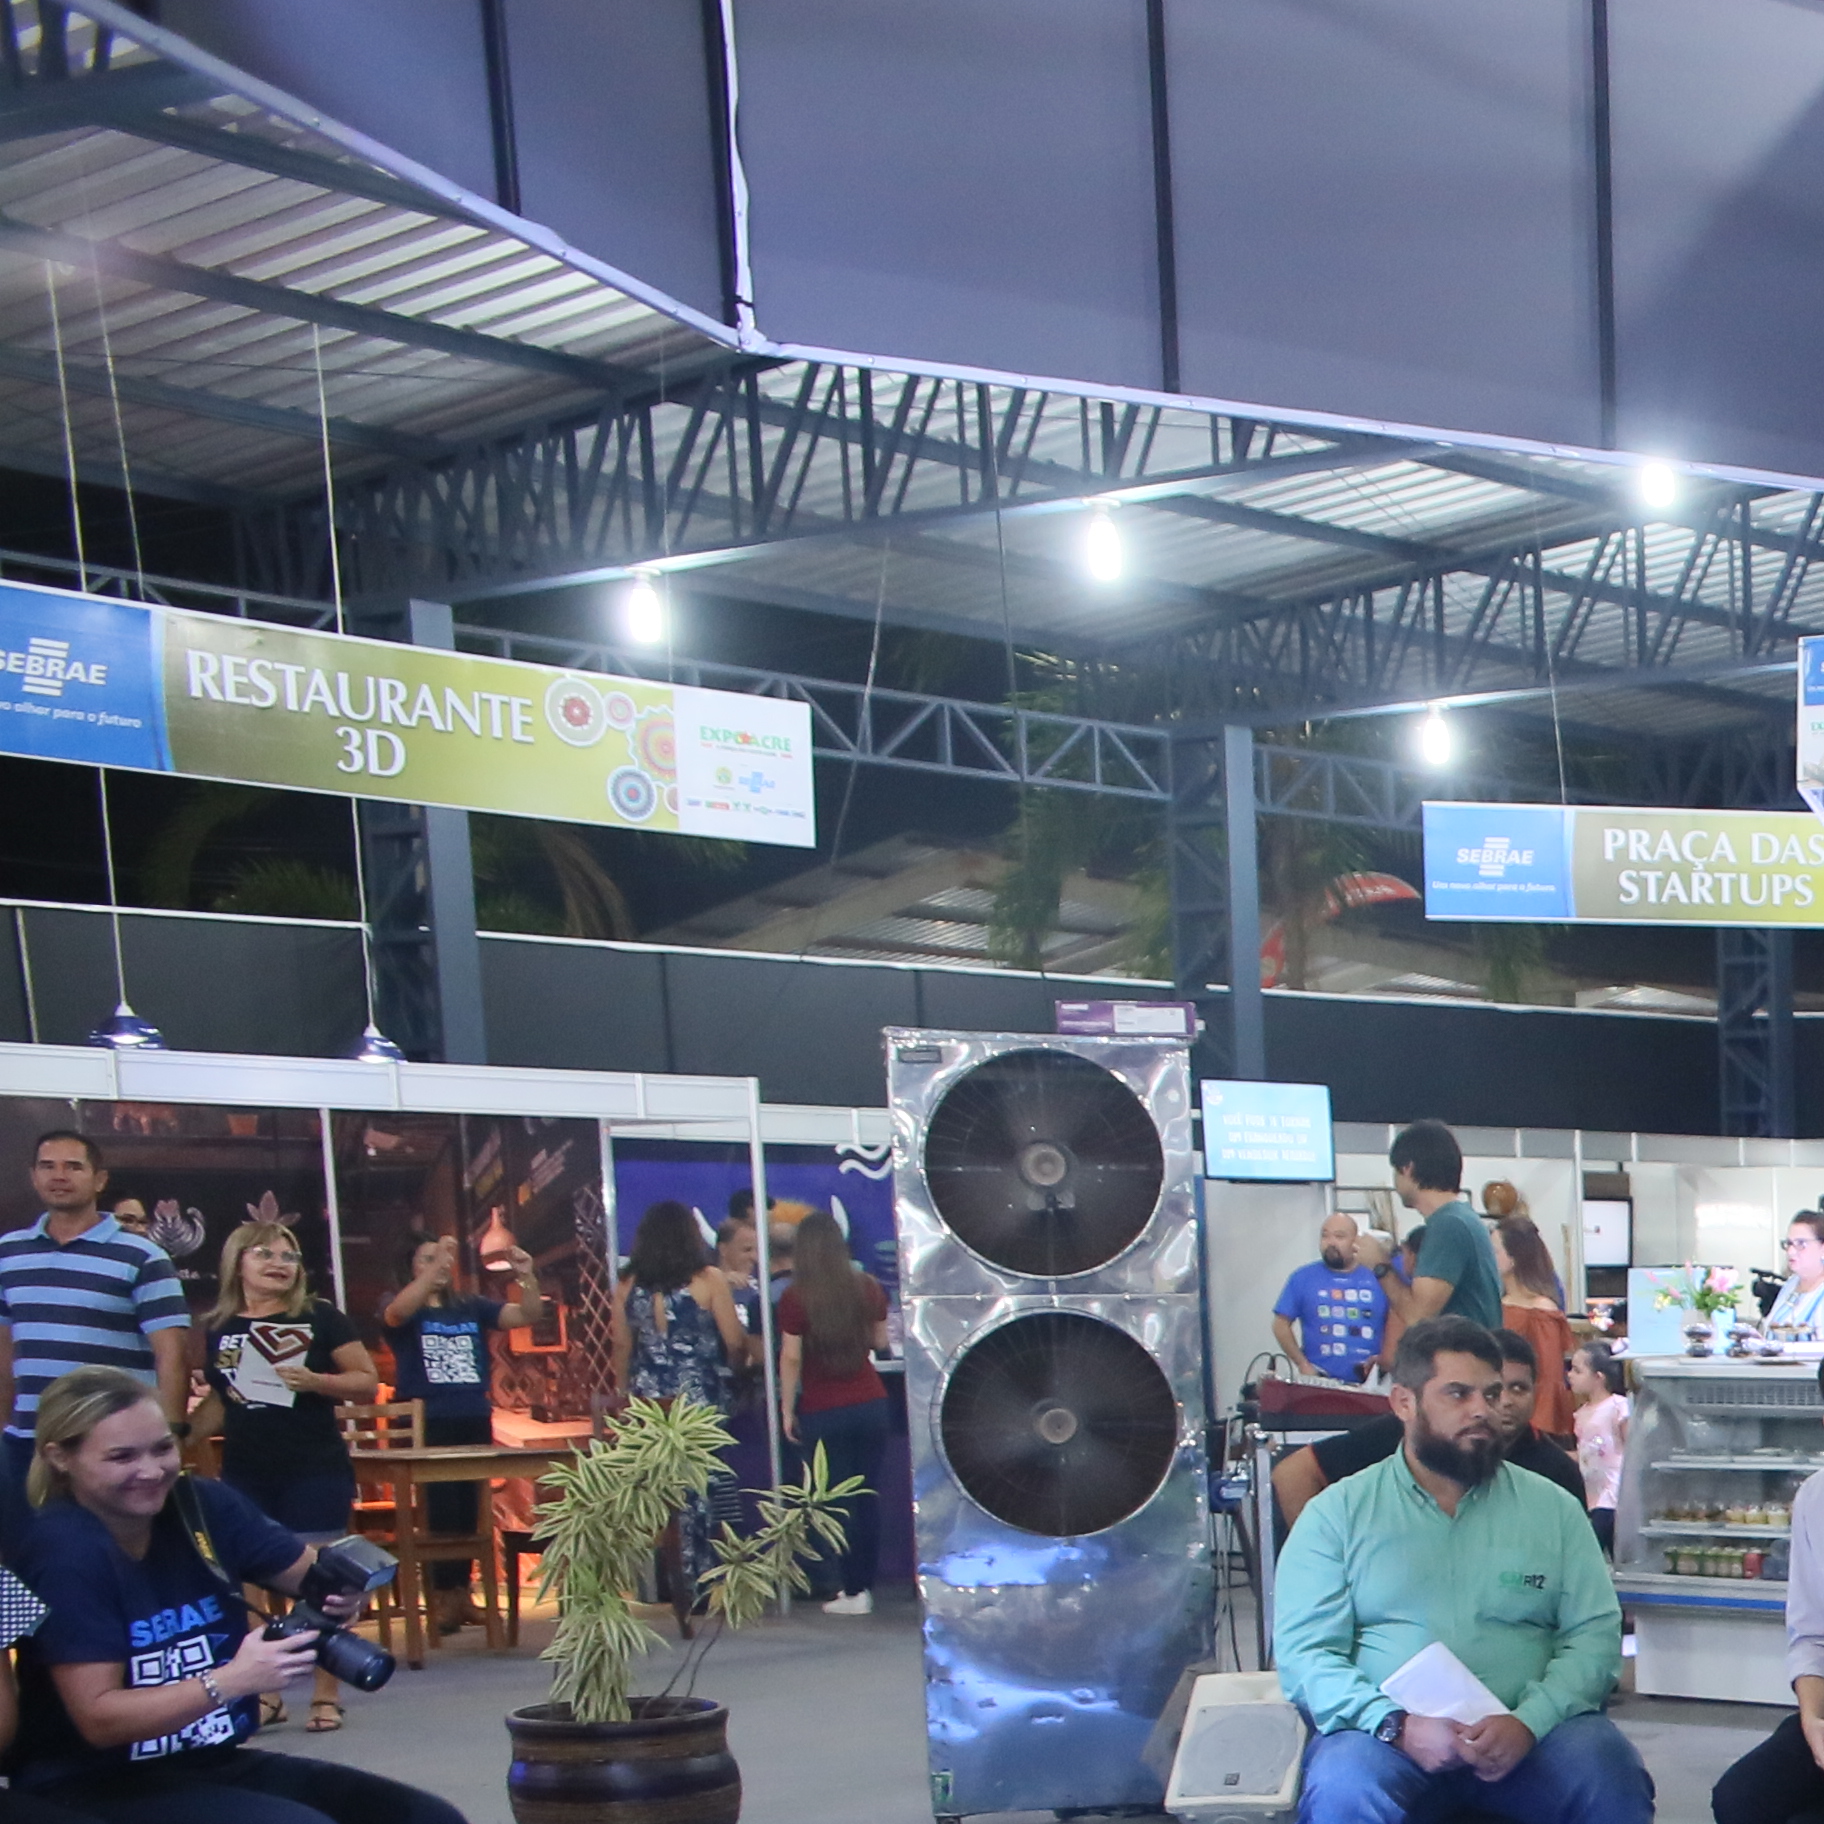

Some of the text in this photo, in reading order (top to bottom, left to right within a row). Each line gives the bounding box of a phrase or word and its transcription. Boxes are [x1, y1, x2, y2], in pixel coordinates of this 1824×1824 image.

[186, 649, 534, 745] RESTAURANTE
[335, 726, 408, 778] 3D
[1456, 848, 1535, 866] SEBRAE
[1603, 828, 1737, 872] PRAÇA
[1618, 870, 1814, 907] STARTUPS
